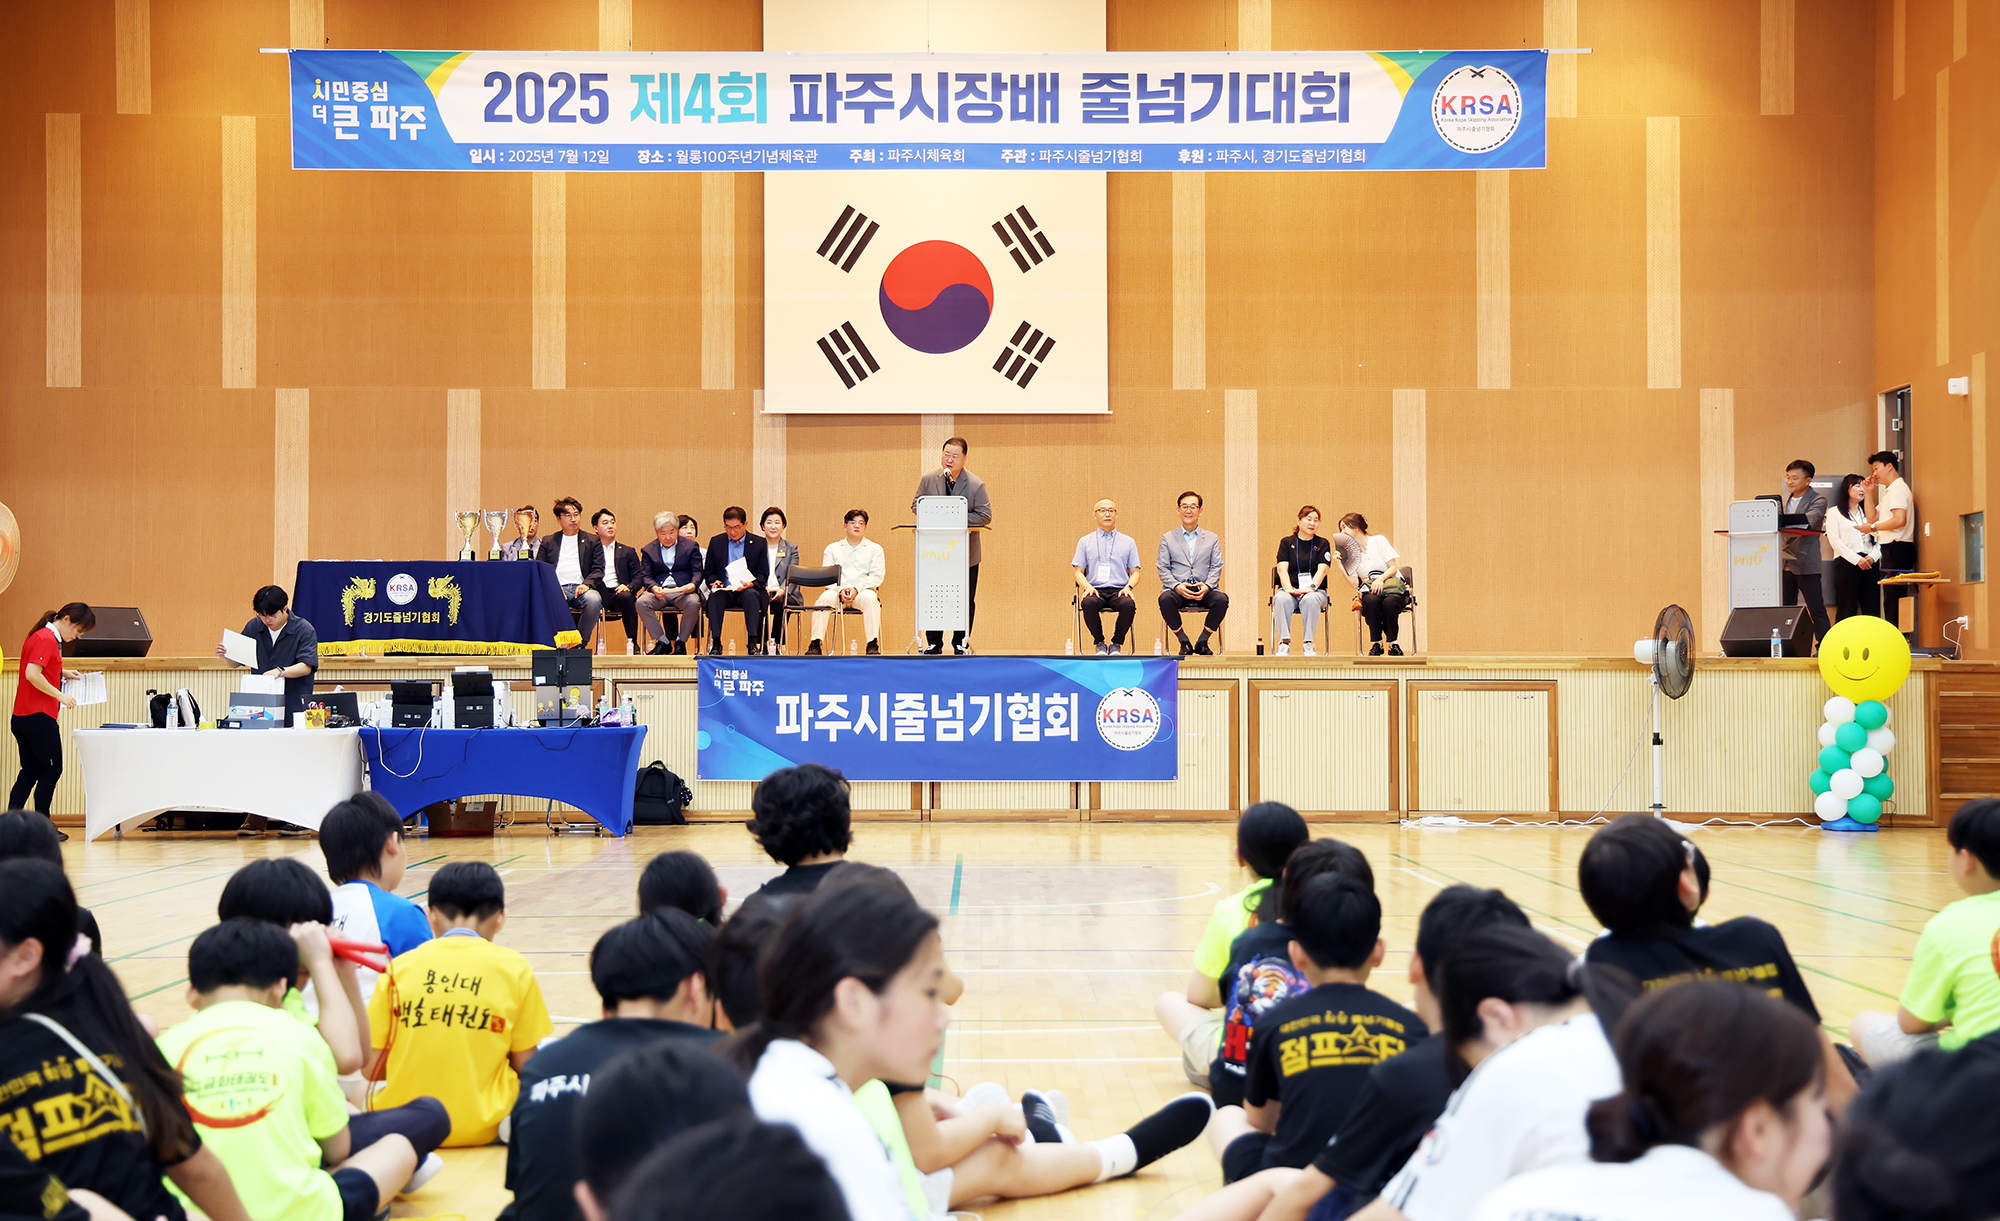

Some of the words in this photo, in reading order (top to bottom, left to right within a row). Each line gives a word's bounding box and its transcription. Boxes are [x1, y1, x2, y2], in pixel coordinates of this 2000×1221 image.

[312, 79, 388, 102] 시민중심
[483, 71, 609, 124] 2025
[630, 71, 767, 124] 제4회
[789, 72, 1060, 124] 파주시장배
[1080, 71, 1350, 124] 줄넘기대회
[1441, 94, 1512, 115] KRSA
[312, 104, 327, 124] 더
[333, 105, 360, 140] 큰
[370, 105, 427, 140] 파주
[469, 148, 495, 164] 일시
[508, 149, 554, 164] 2025년
[558, 149, 578, 164] 7월
[583, 149, 609, 164] 12일
[637, 149, 664, 164] 장소
[676, 149, 818, 164] 월롱100주년기념체육관
[849, 149, 876, 164] 주최
[887, 149, 965, 163] 파주시체육회
[1000, 149, 1027, 163] 주관
[1038, 149, 1142, 163] 파주시줄넘기협회
[1177, 149, 1204, 163] 후원
[1216, 149, 1258, 164] 파주시,
[1262, 149, 1366, 163] 경기도줄넘기협회
[922, 550, 950, 562] PAJU
[1734, 555, 1762, 567] PAJU
[363, 611, 440, 624] 경기도줄넘기협회
[714, 669, 748, 680] 시민중심
[723, 680, 735, 696] 큰
[739, 681, 765, 697] 파주
[775, 692, 1079, 742] 파주시줄넘기협회
[1103, 708, 1153, 723] KRSA
[423, 969, 483, 996] 용인대
